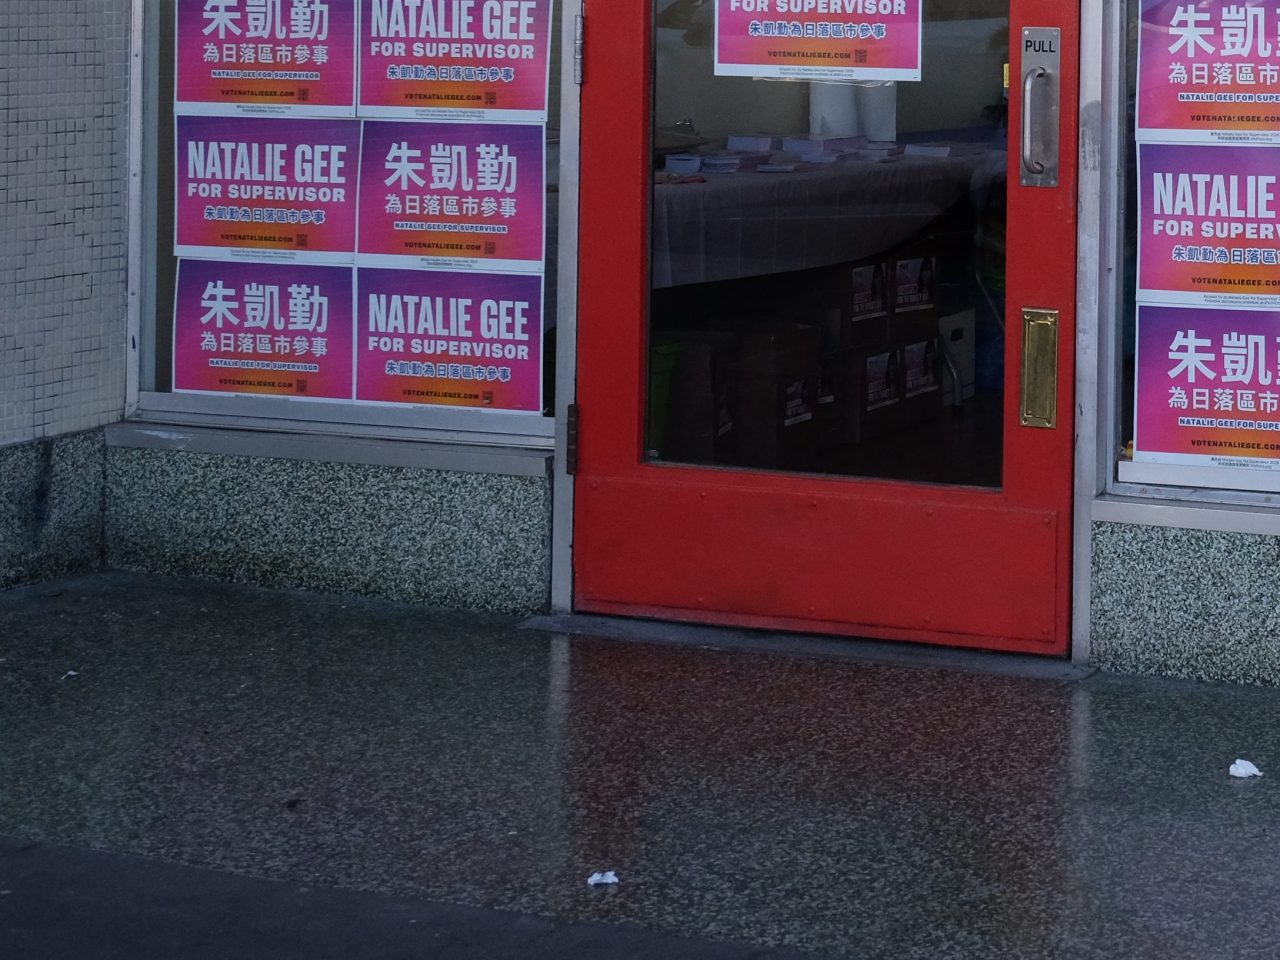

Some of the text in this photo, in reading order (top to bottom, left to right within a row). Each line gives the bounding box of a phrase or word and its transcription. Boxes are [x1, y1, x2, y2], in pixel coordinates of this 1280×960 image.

[370, 0, 533, 39] NATALIE GEE
[203, 43, 329, 65] 為日落區市參事
[370, 42, 533, 59] FOR SUPERVISOR
[768, 51, 851, 59] VOTENATALIEGEE.COM
[1025, 40, 1056, 53] PULL
[1178, 93, 1214, 101] NATALIE
[1217, 94, 1234, 102] GEE
[1236, 94, 1254, 102] FOR
[189, 143, 344, 183] NATALIE GEE
[384, 141, 517, 193] 朱凱勤
[189, 184, 344, 202] FOR SUPERVISOR
[1152, 175, 1277, 218] NATALIE
[385, 194, 517, 218] 為日落區市參事
[1152, 221, 1193, 236] FOR
[200, 280, 328, 333] 朱凱勤
[369, 293, 528, 340] NATALIE GEE
[201, 331, 328, 357] 為日落區市參事
[369, 336, 529, 359] FOR SUPERVISOR
